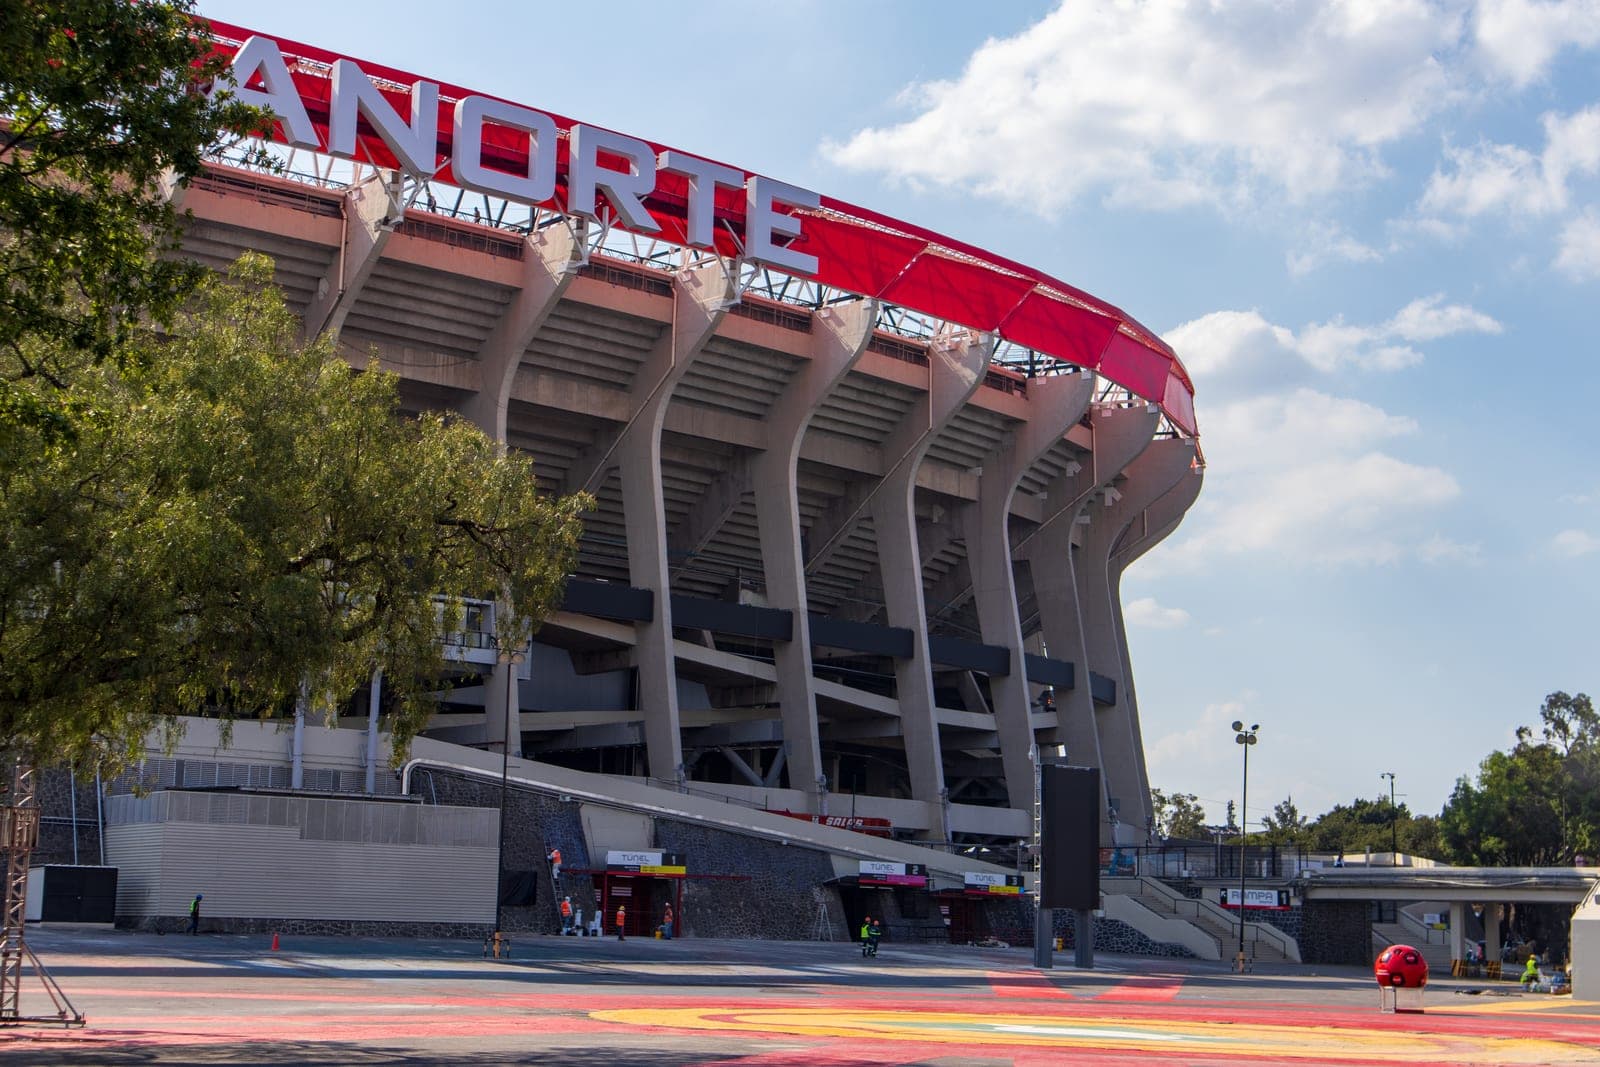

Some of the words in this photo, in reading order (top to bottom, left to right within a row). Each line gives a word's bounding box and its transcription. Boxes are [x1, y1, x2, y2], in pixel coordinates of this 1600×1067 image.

[202, 35, 821, 276] ANORTE
[671, 855, 676, 865] 1
[912, 865, 919, 875] 2
[1012, 876, 1018, 886] 3
[1280, 892, 1287, 905] 1
